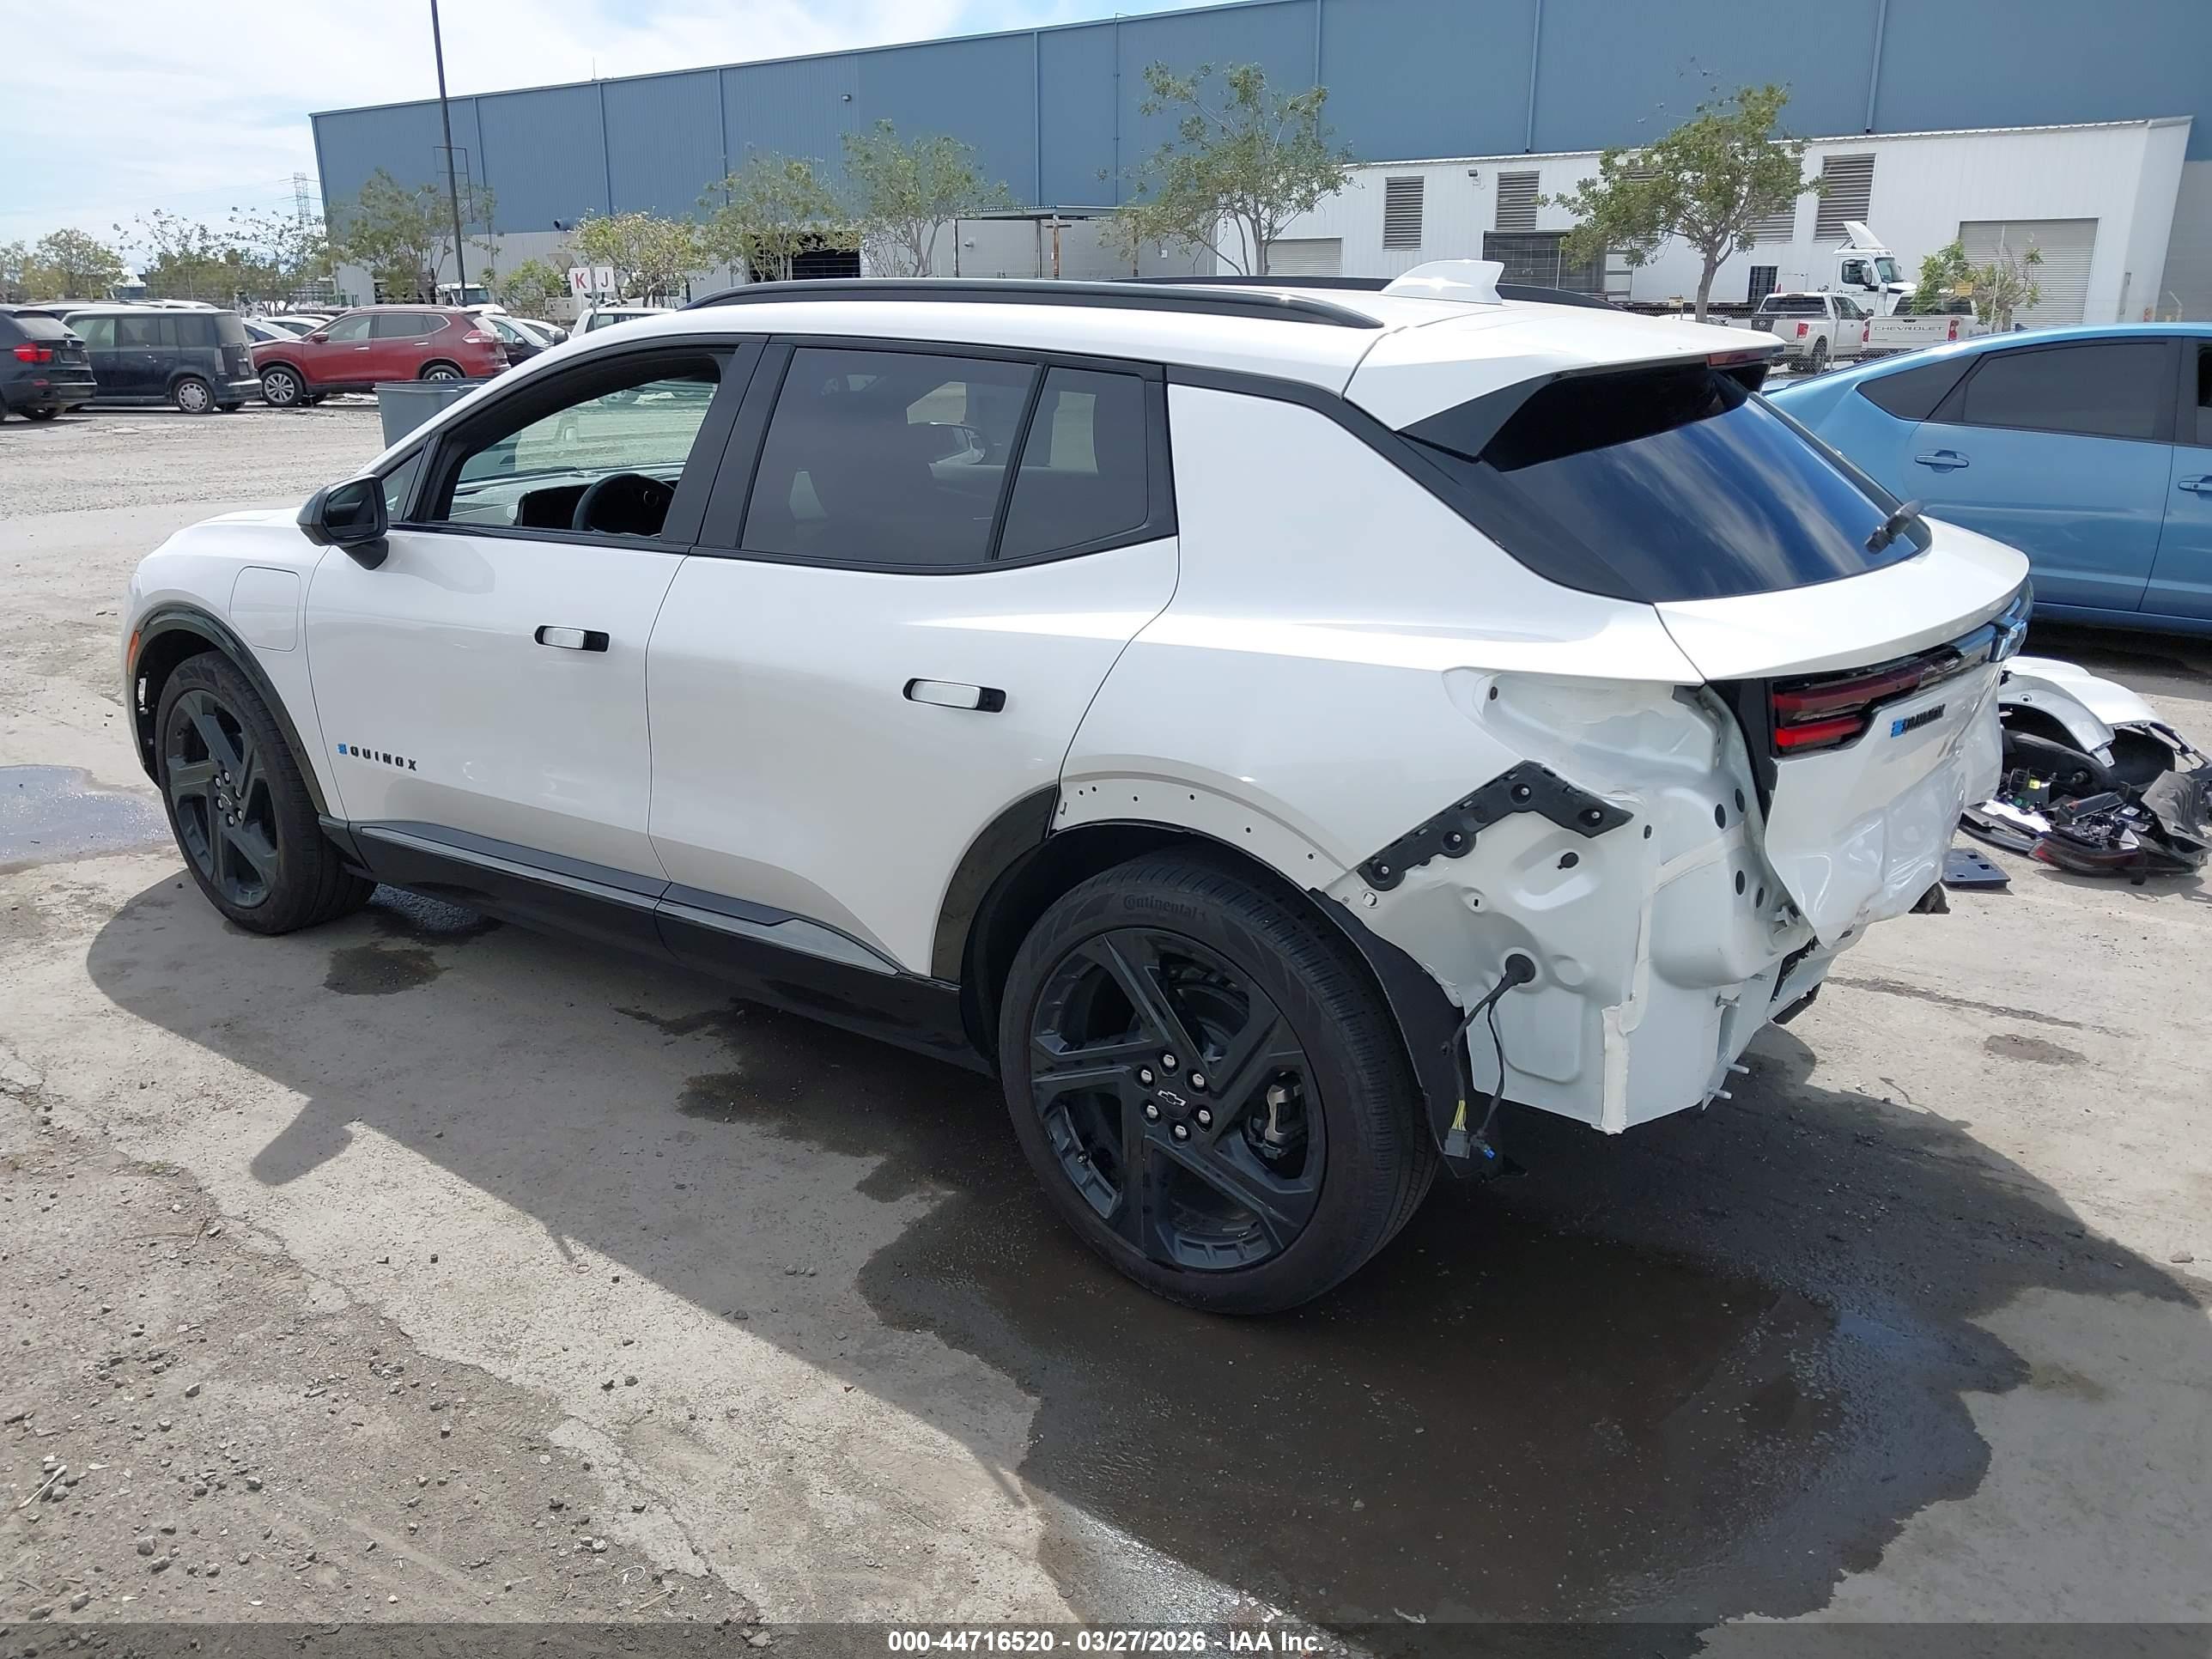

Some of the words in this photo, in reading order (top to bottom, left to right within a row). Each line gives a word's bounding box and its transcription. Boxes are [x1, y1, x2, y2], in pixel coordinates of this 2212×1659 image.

[574, 273, 587, 289] K
[600, 271, 609, 288] J
[337, 743, 416, 771] EQUINOX
